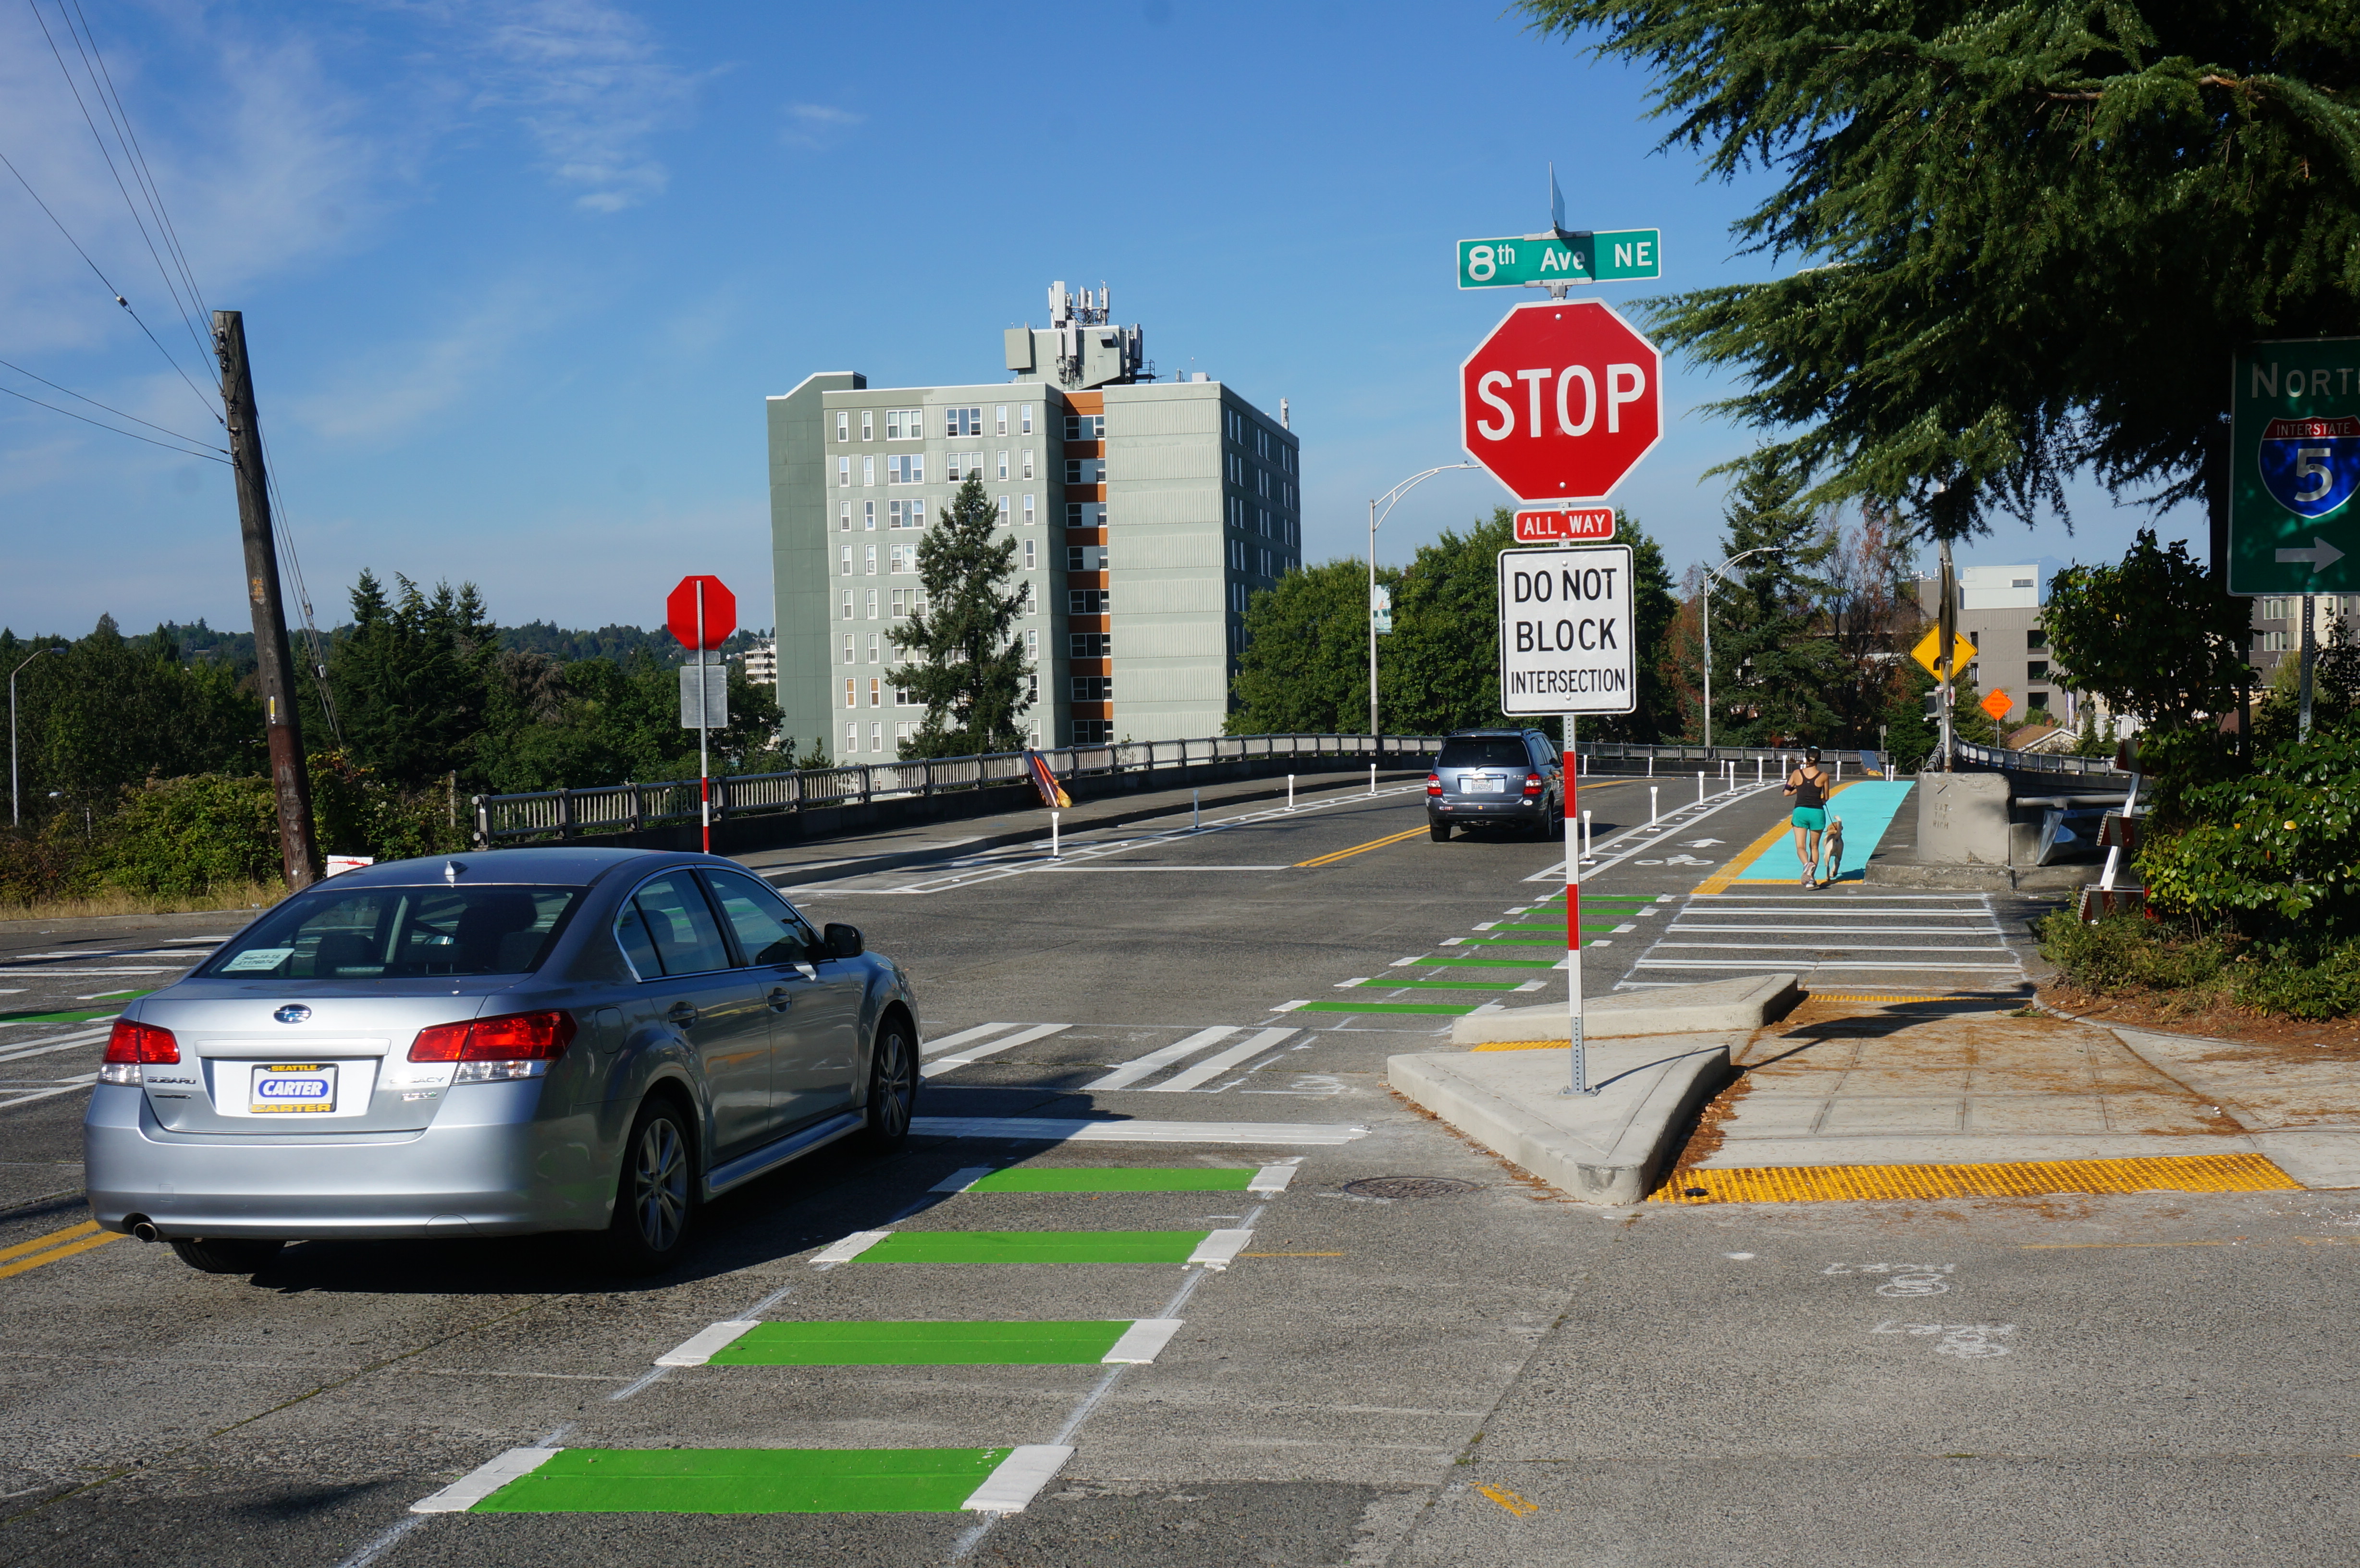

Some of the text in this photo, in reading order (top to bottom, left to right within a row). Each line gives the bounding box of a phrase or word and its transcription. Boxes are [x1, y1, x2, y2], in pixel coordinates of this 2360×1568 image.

[1468, 242, 1652, 281] 8th Ave NE
[2252, 362, 2360, 398] NORT
[1477, 363, 1646, 441] STOP
[2277, 422, 2351, 436] INTERSTATE
[2294, 447, 2333, 502] 5
[1524, 514, 1606, 536] ALL WAY
[1514, 568, 1617, 603] DO NOT
[1516, 618, 1617, 652] BLOCK
[1511, 668, 1625, 694] INTERSECTION
[147, 1076, 197, 1084] SUBARU
[263, 1081, 323, 1095] CARTER
[251, 1104, 331, 1113] CARTER
